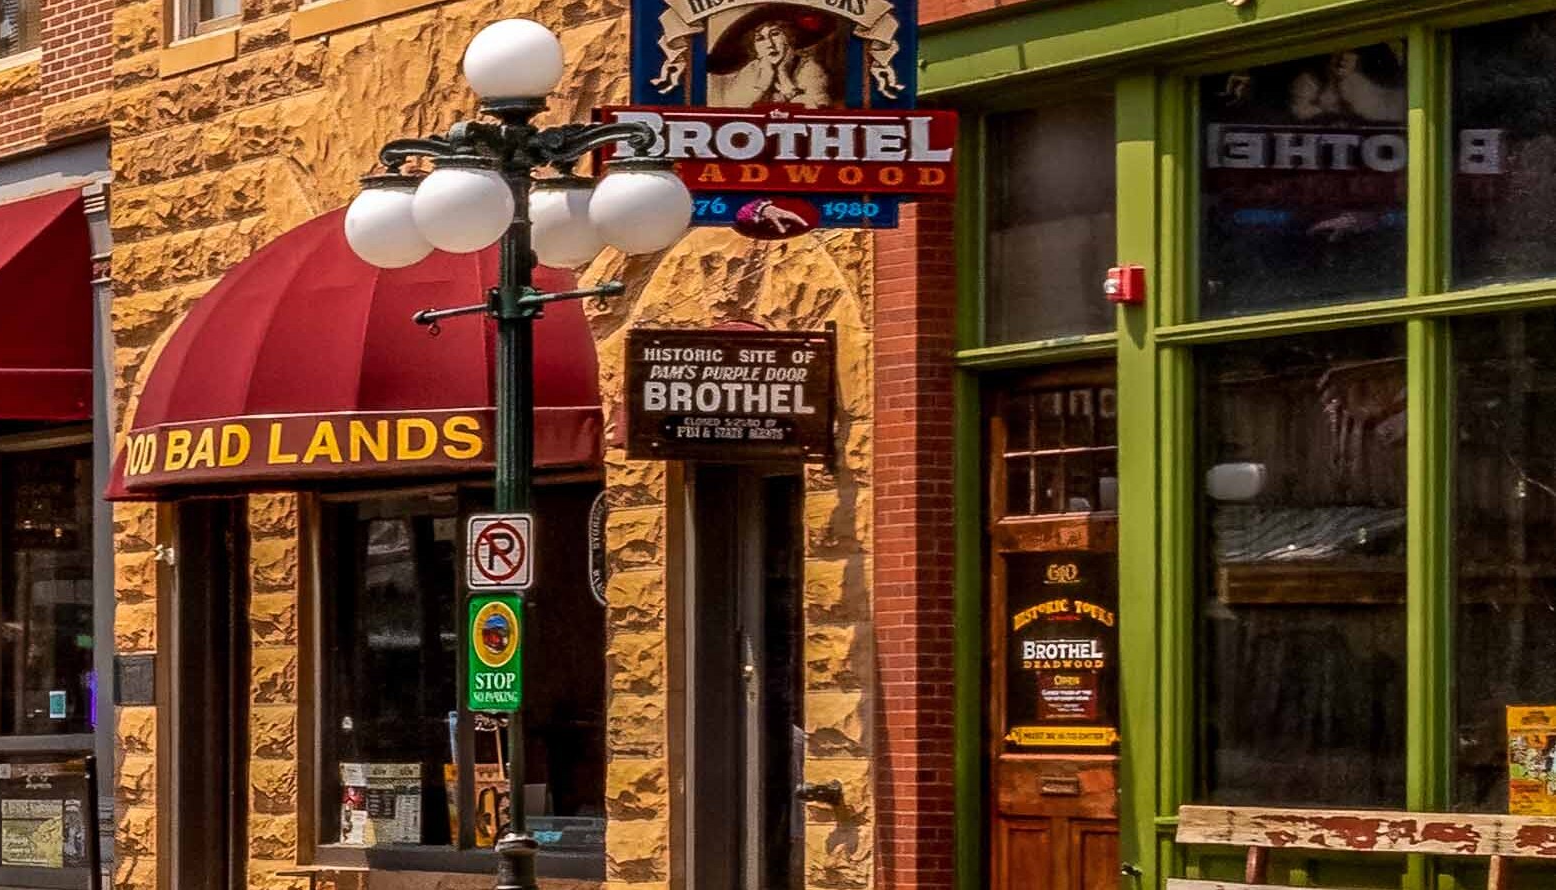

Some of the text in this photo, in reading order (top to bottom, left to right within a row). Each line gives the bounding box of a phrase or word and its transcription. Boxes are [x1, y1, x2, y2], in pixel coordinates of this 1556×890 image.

[612, 110, 954, 162] BROTHEL
[697, 163, 947, 186] ADWOOD
[822, 202, 880, 218] 1980
[643, 348, 817, 364] HISTORIC SITE OF
[649, 364, 809, 382] PAM'S PURPLE DOOR
[643, 381, 817, 414] BROTHEL
[163, 423, 251, 473] BAD
[267, 415, 484, 466] LANDS
[1013, 599, 1069, 631] HISTORIC
[1022, 639, 1104, 660] BROTHEL
[1022, 660, 1105, 669] DEADWOOD
[475, 672, 516, 690] STOP
